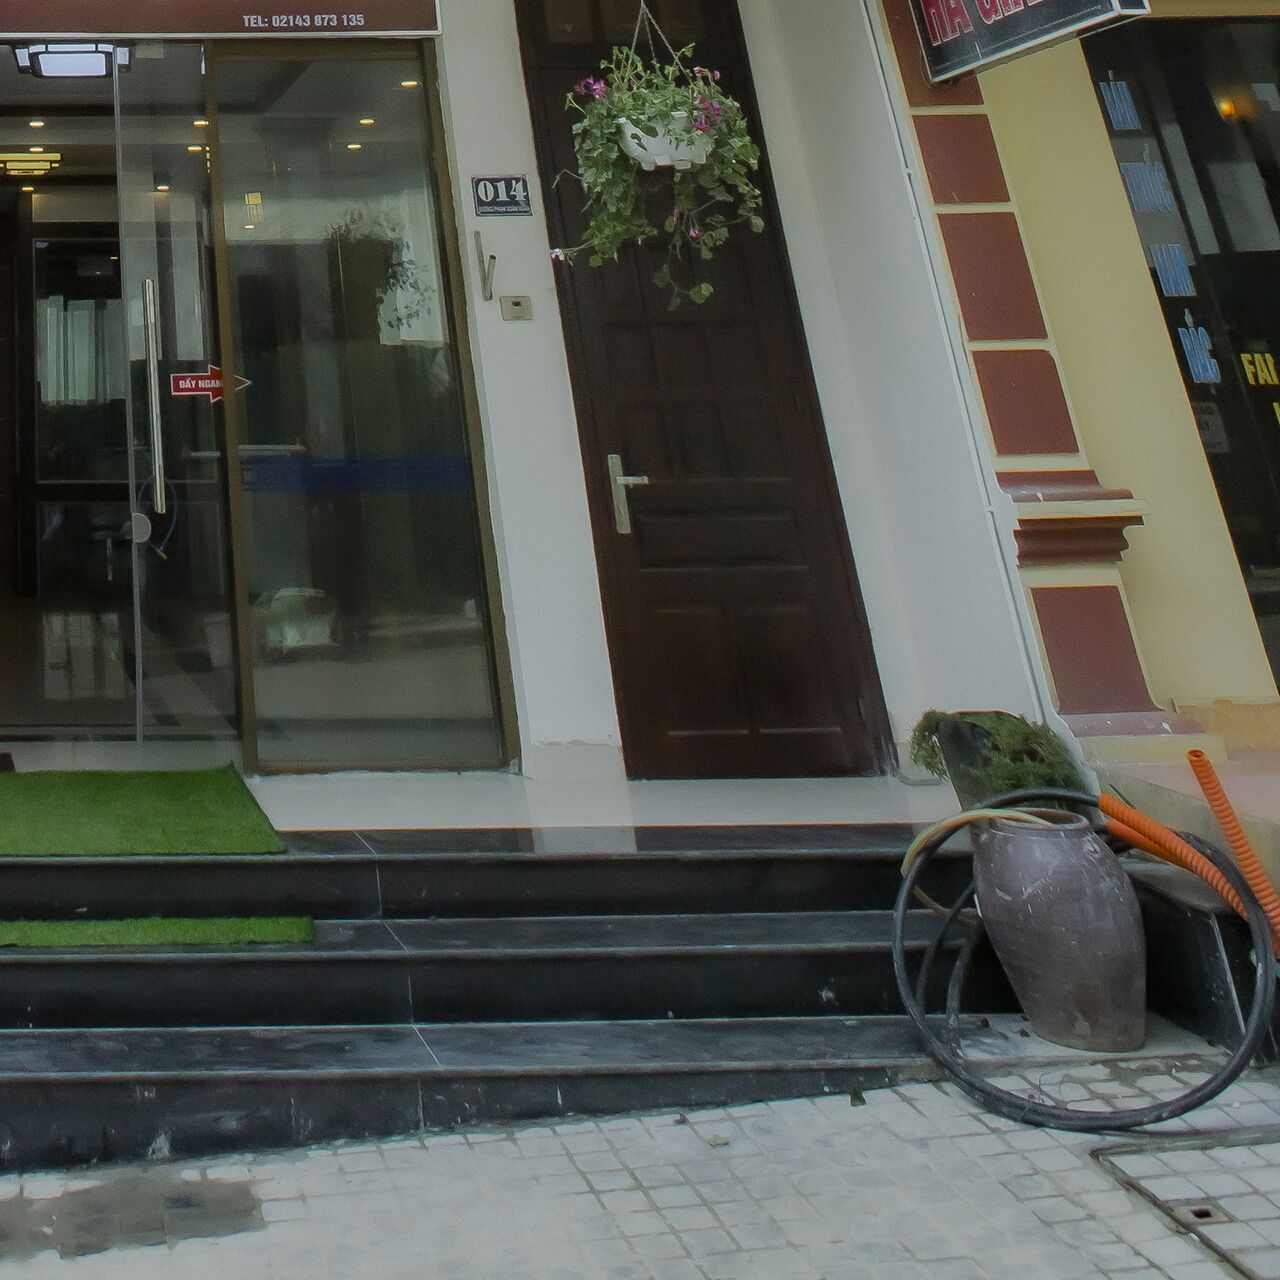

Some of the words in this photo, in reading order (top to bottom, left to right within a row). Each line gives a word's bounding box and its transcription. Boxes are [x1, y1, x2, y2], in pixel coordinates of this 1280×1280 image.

[243, 15, 268, 27] TEL:
[272, 15, 310, 26] 02143
[314, 14, 337, 26] 873
[341, 14, 365, 26] 135
[477, 179, 527, 202] 014
